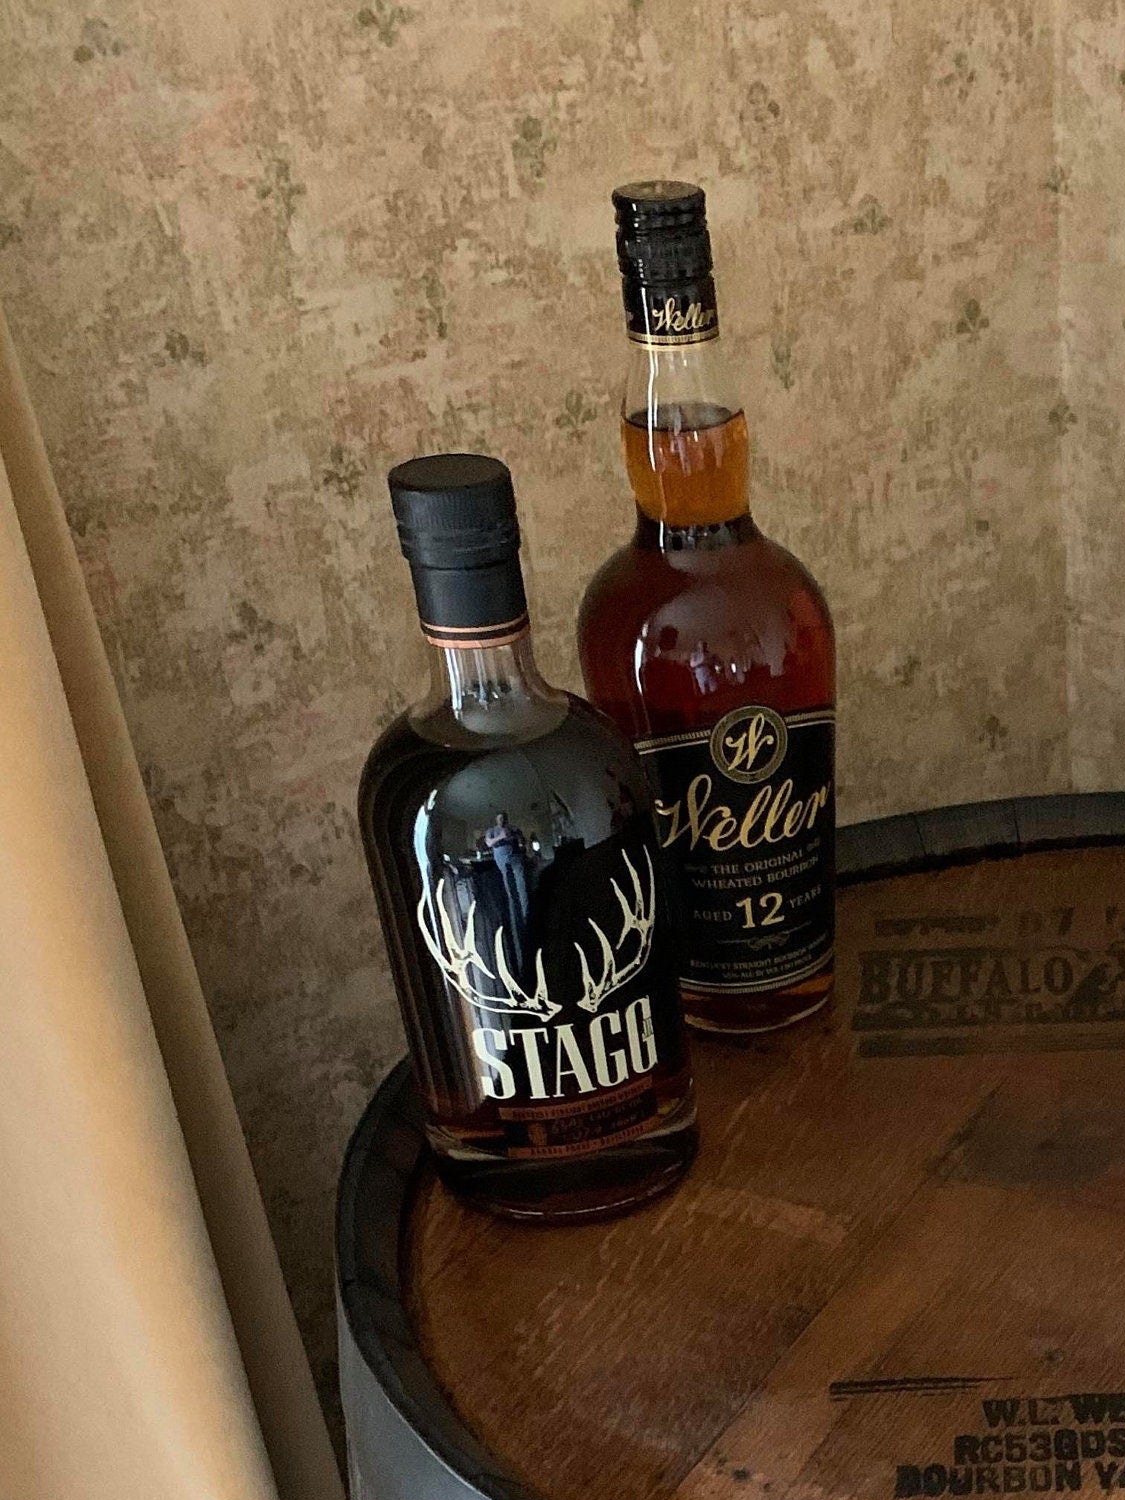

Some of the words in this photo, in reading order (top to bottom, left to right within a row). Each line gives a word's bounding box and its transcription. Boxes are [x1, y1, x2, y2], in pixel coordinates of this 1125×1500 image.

[654, 774, 830, 852] Weller
[691, 876, 763, 890] WHEATED
[767, 855, 819, 883] BOURBON
[710, 863, 739, 875] THE
[744, 849, 803, 873] ORIGINAL
[693, 909, 732, 922] AGED
[735, 892, 785, 929] 12
[789, 884, 822, 909] YEARS
[472, 994, 658, 1100] STAGG
[895, 1462, 1082, 1498] BOURBON
